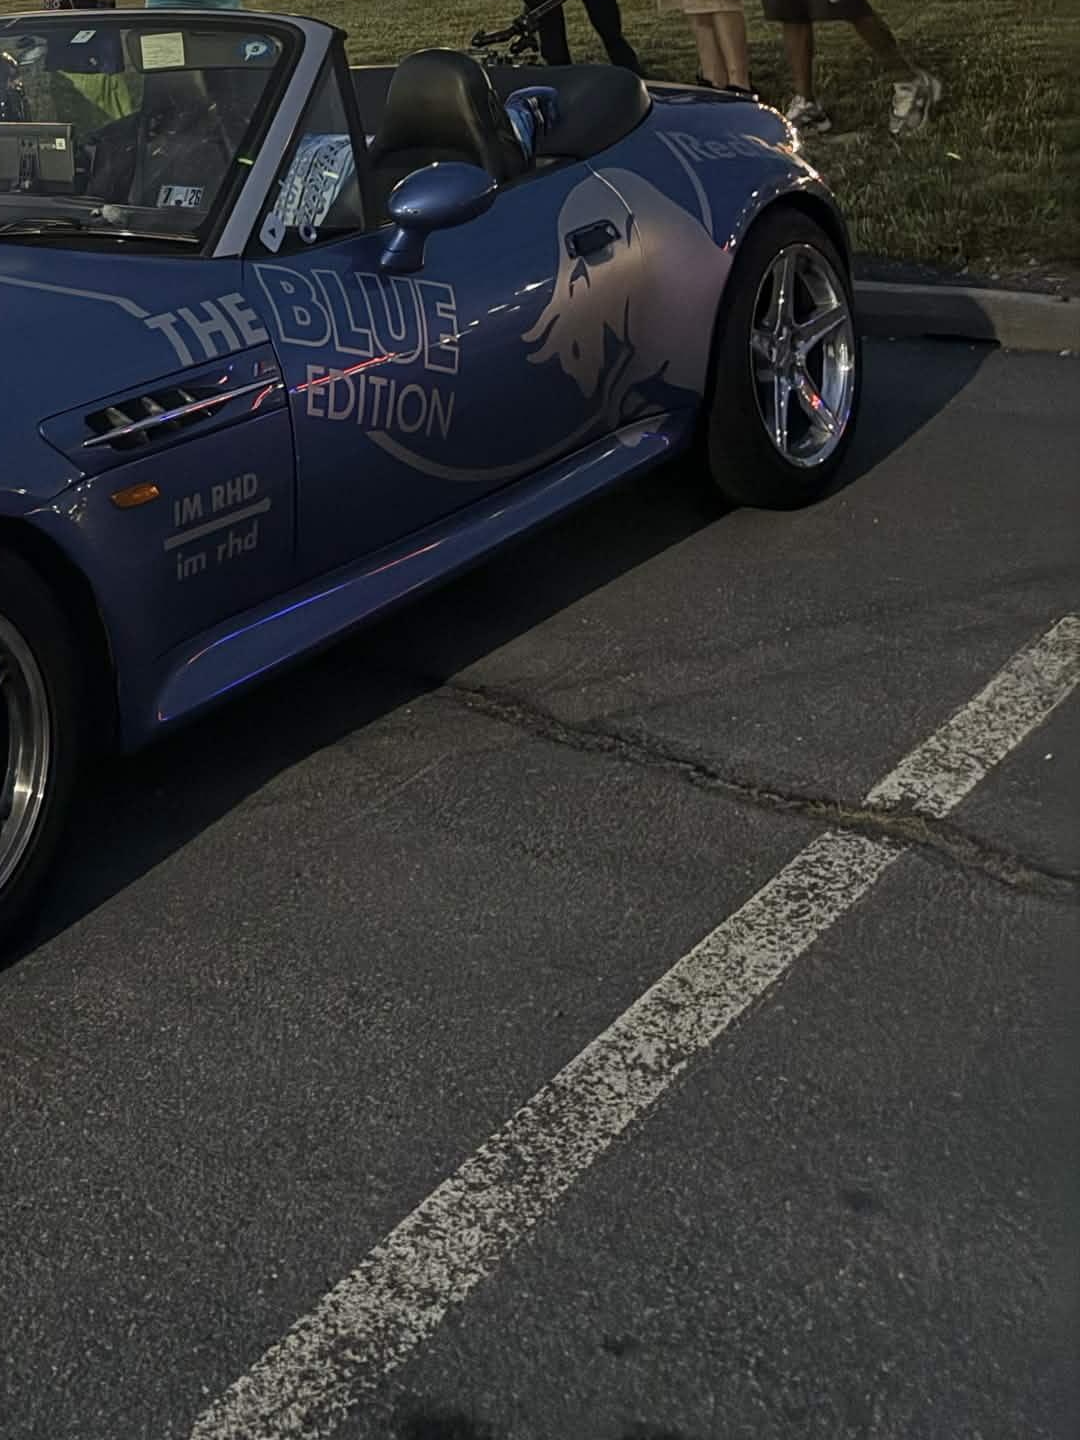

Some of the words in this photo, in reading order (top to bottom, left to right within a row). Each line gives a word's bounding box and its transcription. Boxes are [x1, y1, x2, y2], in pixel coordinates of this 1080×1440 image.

[143, 292, 270, 367] THE
[252, 263, 459, 375] BLUE
[306, 364, 456, 440] EDITION
[174, 492, 203, 528] IM
[211, 472, 257, 513] RHD
[176, 551, 206, 581] im
[216, 519, 258, 565] rhd
